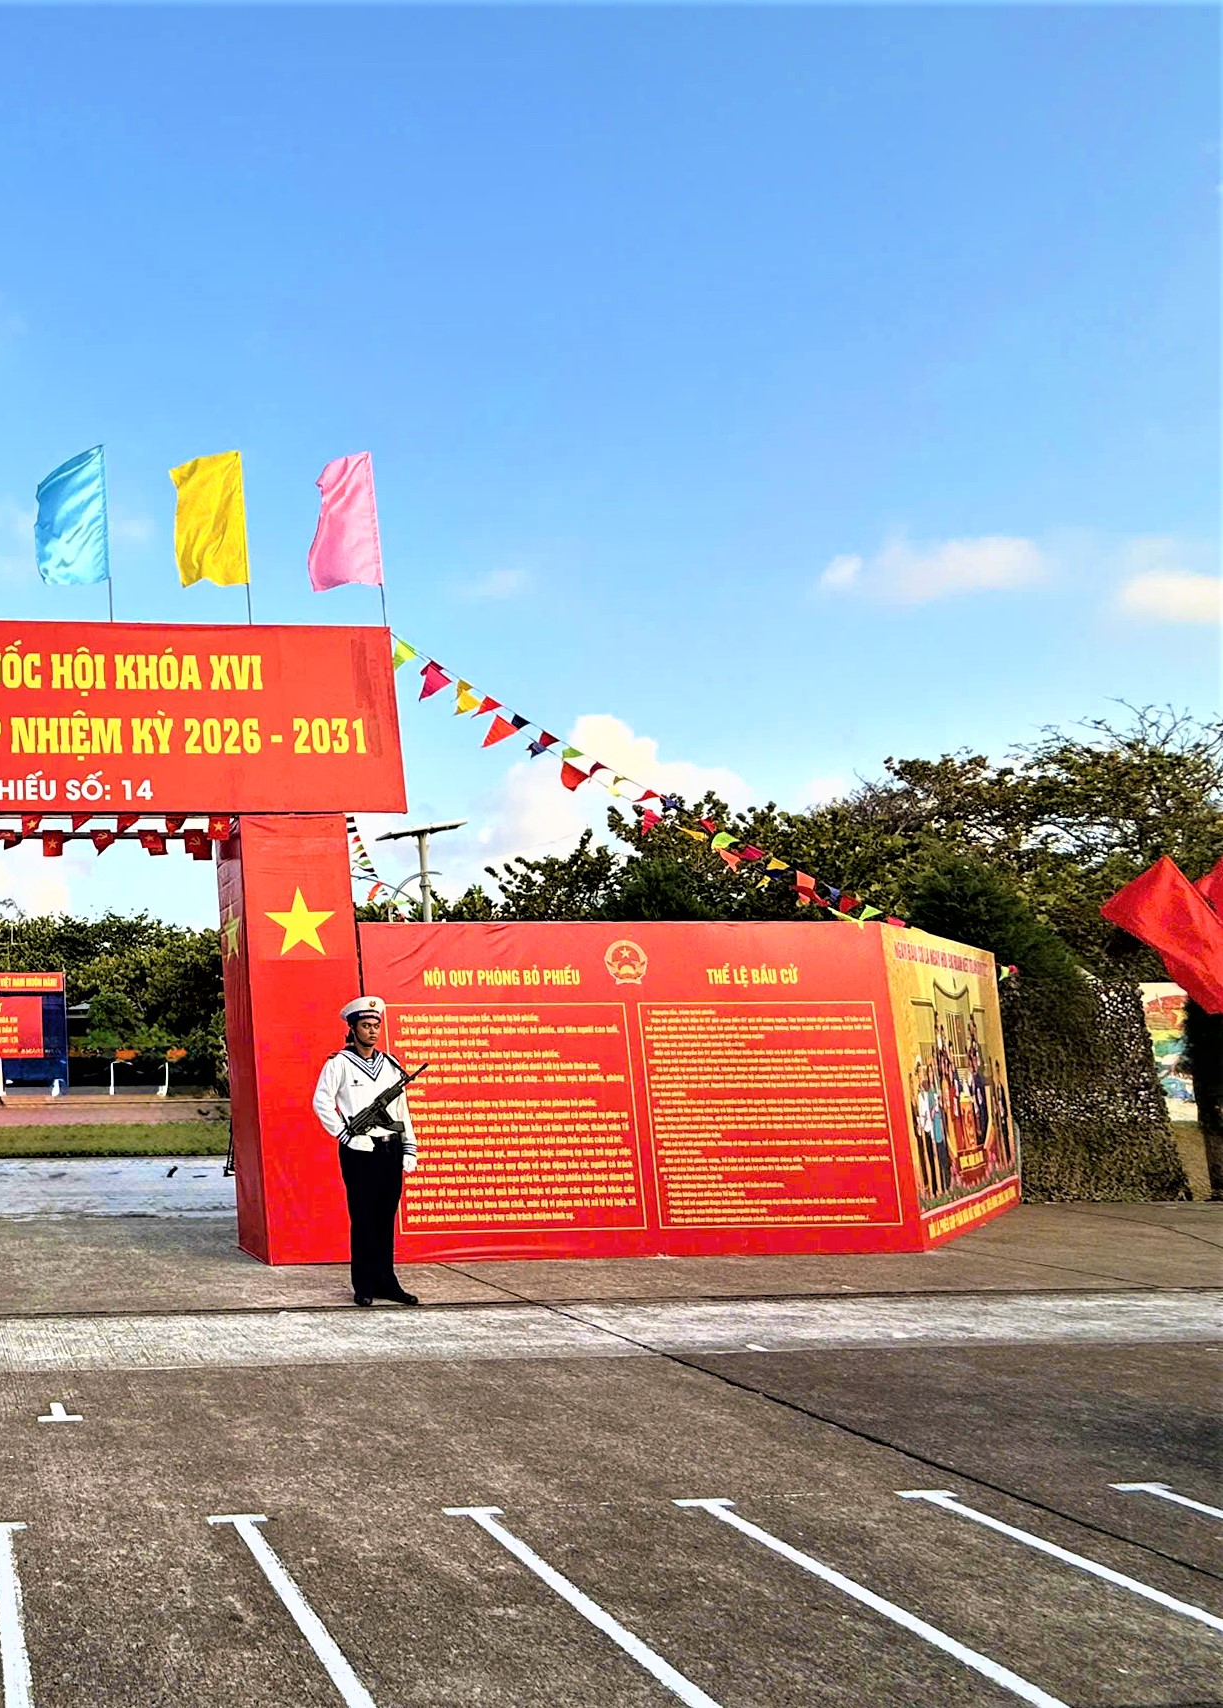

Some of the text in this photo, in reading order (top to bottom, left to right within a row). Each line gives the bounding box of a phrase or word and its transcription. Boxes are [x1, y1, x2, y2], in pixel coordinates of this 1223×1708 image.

[50, 646, 106, 697] HỘI
[114, 647, 202, 690] KHÓA
[209, 654, 264, 690] XVI
[11, 709, 123, 761] NHIỆM
[131, 709, 174, 755] KỲ
[184, 718, 262, 755] 2026
[270, 735, 283, 744] -
[292, 718, 367, 754] 2031
[65, 770, 111, 801] SỐ:
[121, 779, 154, 800] 14
[423, 964, 580, 990] NỘI QUY PHÒNG BỎ PHIẾU
[706, 962, 798, 988] THỂ LỆ BẦU CỬ
